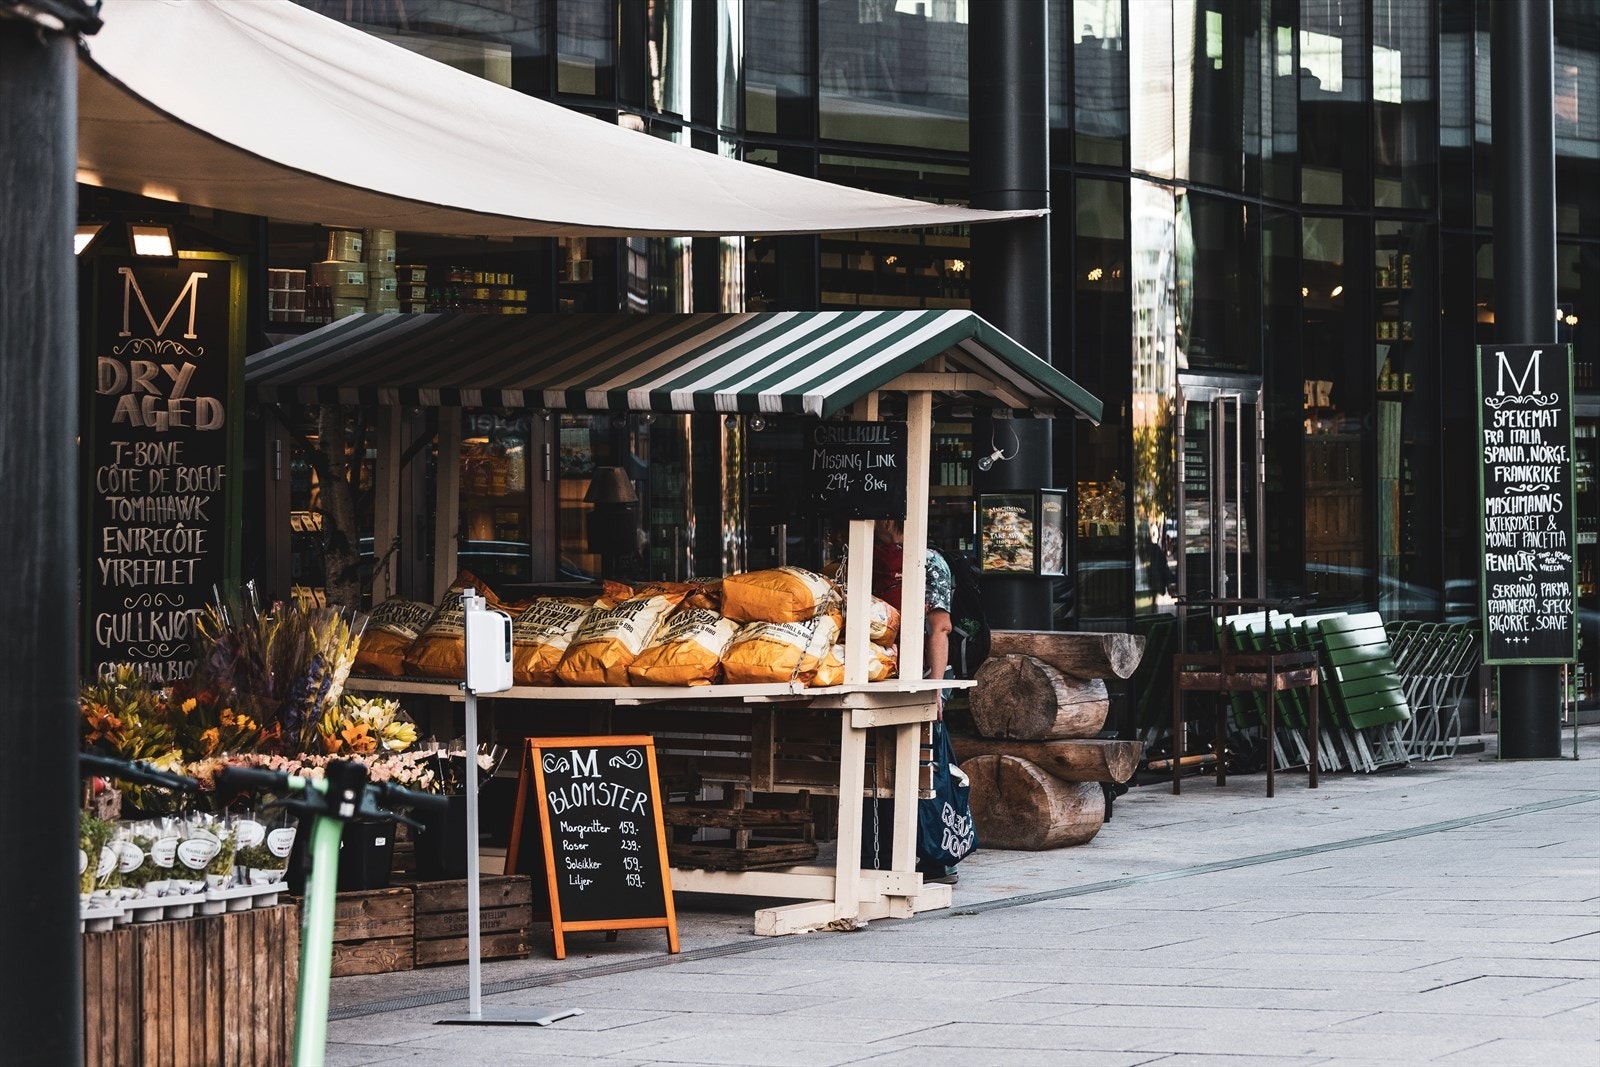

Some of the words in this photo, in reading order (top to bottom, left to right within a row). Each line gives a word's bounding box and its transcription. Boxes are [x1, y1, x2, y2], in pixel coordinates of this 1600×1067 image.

[118, 267, 208, 339] M
[96, 356, 197, 399] DRY
[1495, 350, 1543, 396] M
[112, 393, 225, 432] AGED
[1493, 409, 1561, 428] SPEKEMAT
[1484, 429, 1504, 445] FRA
[110, 441, 184, 467] T-BONE
[97, 463, 143, 494] CÔTE
[149, 468, 171, 493] DE
[176, 465, 226, 493] BOEUF
[1494, 465, 1561, 483] FRANKRIKE
[105, 495, 210, 524] TOMAHAWK
[1485, 493, 1563, 516] MASCHMANNS
[1547, 514, 1557, 531] &
[103, 522, 208, 556] ENTRECÔTE
[1522, 530, 1566, 549] PANCETTA
[98, 557, 201, 587] YTREFILET
[1535, 615, 1568, 630] SOAVE
[569, 749, 602, 778] M
[548, 782, 648, 816] BLOMSTER
[560, 819, 610, 839] Margeritter
[562, 840, 589, 850] Roser
[565, 856, 602, 870] Solsikker
[569, 874, 593, 890] Liljer
